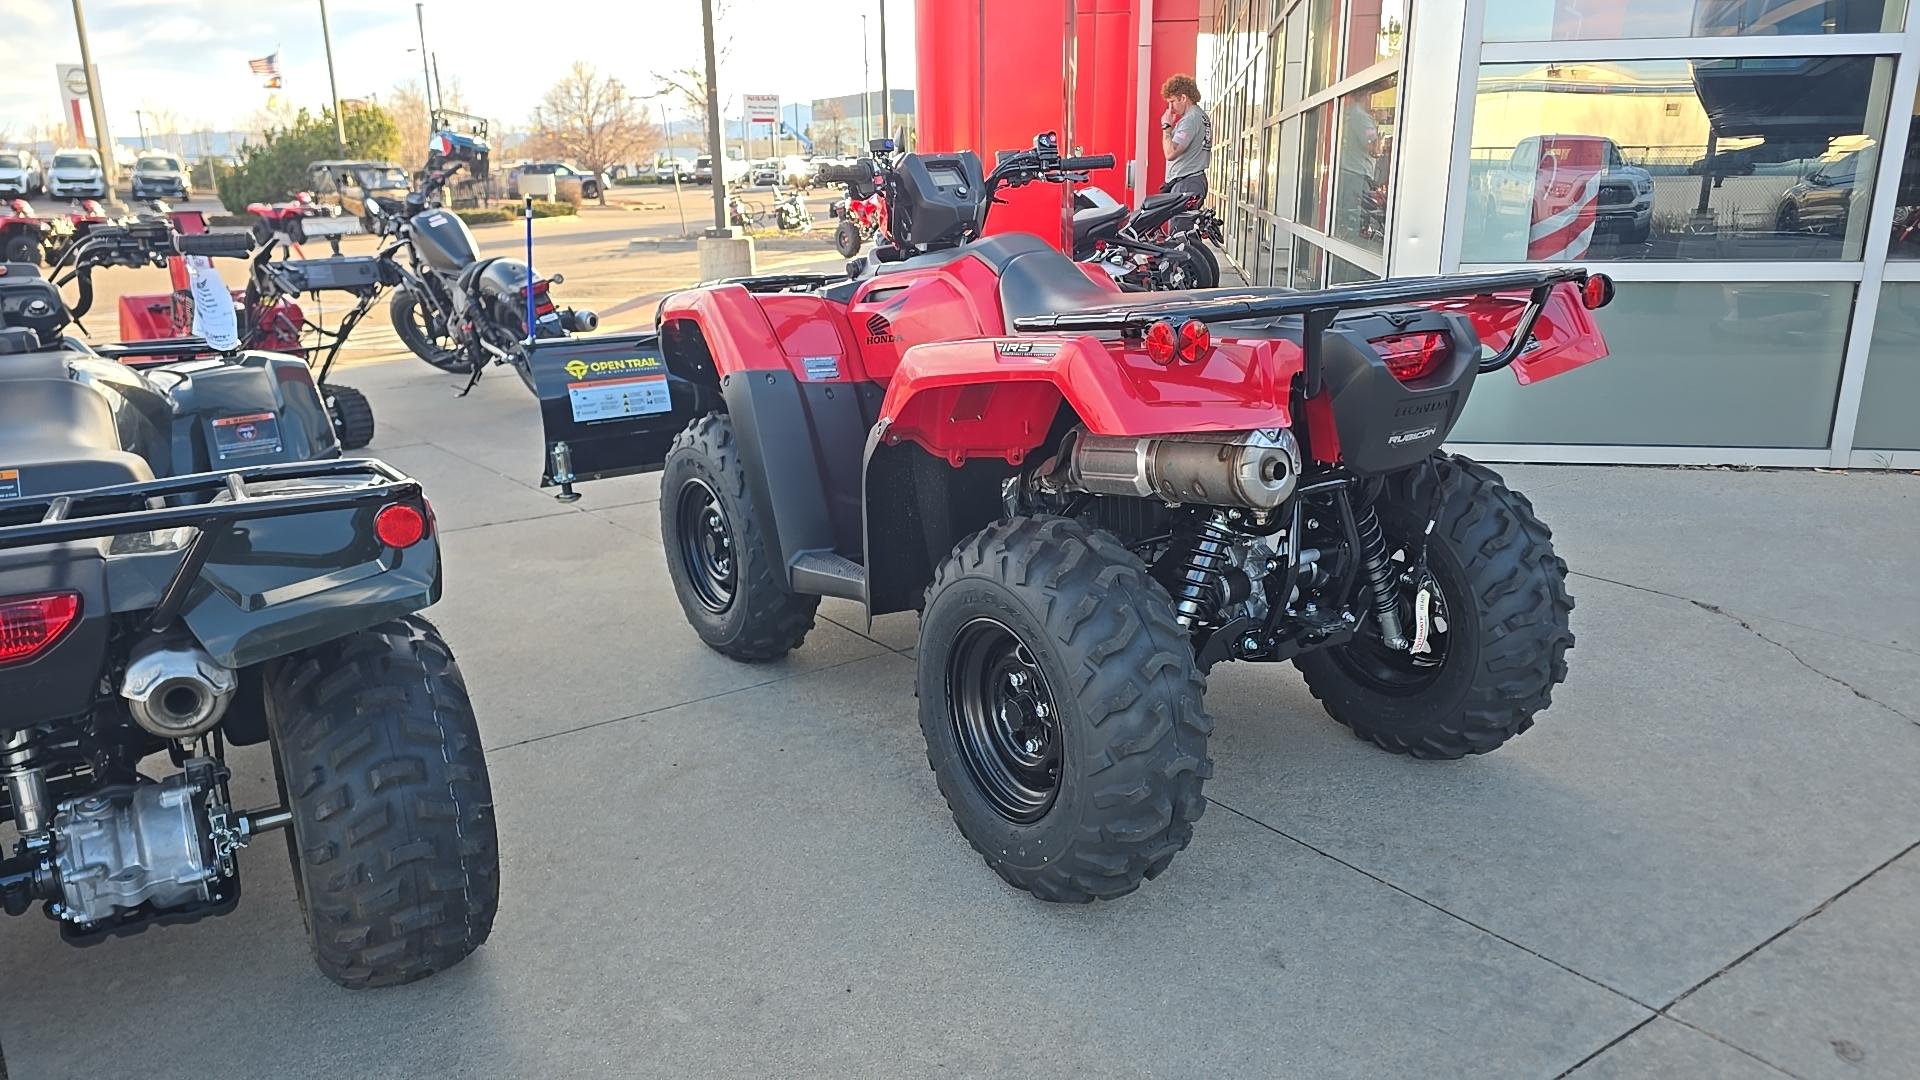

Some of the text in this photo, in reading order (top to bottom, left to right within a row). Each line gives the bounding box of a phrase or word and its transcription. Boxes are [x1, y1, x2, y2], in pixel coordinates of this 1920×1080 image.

[866, 334, 904, 345] HONDA
[1001, 343, 1033, 352] IRS
[590, 357, 662, 372] OPEN TRAIL
[1394, 400, 1449, 417] HONDA
[1387, 427, 1437, 444] RUBICON
